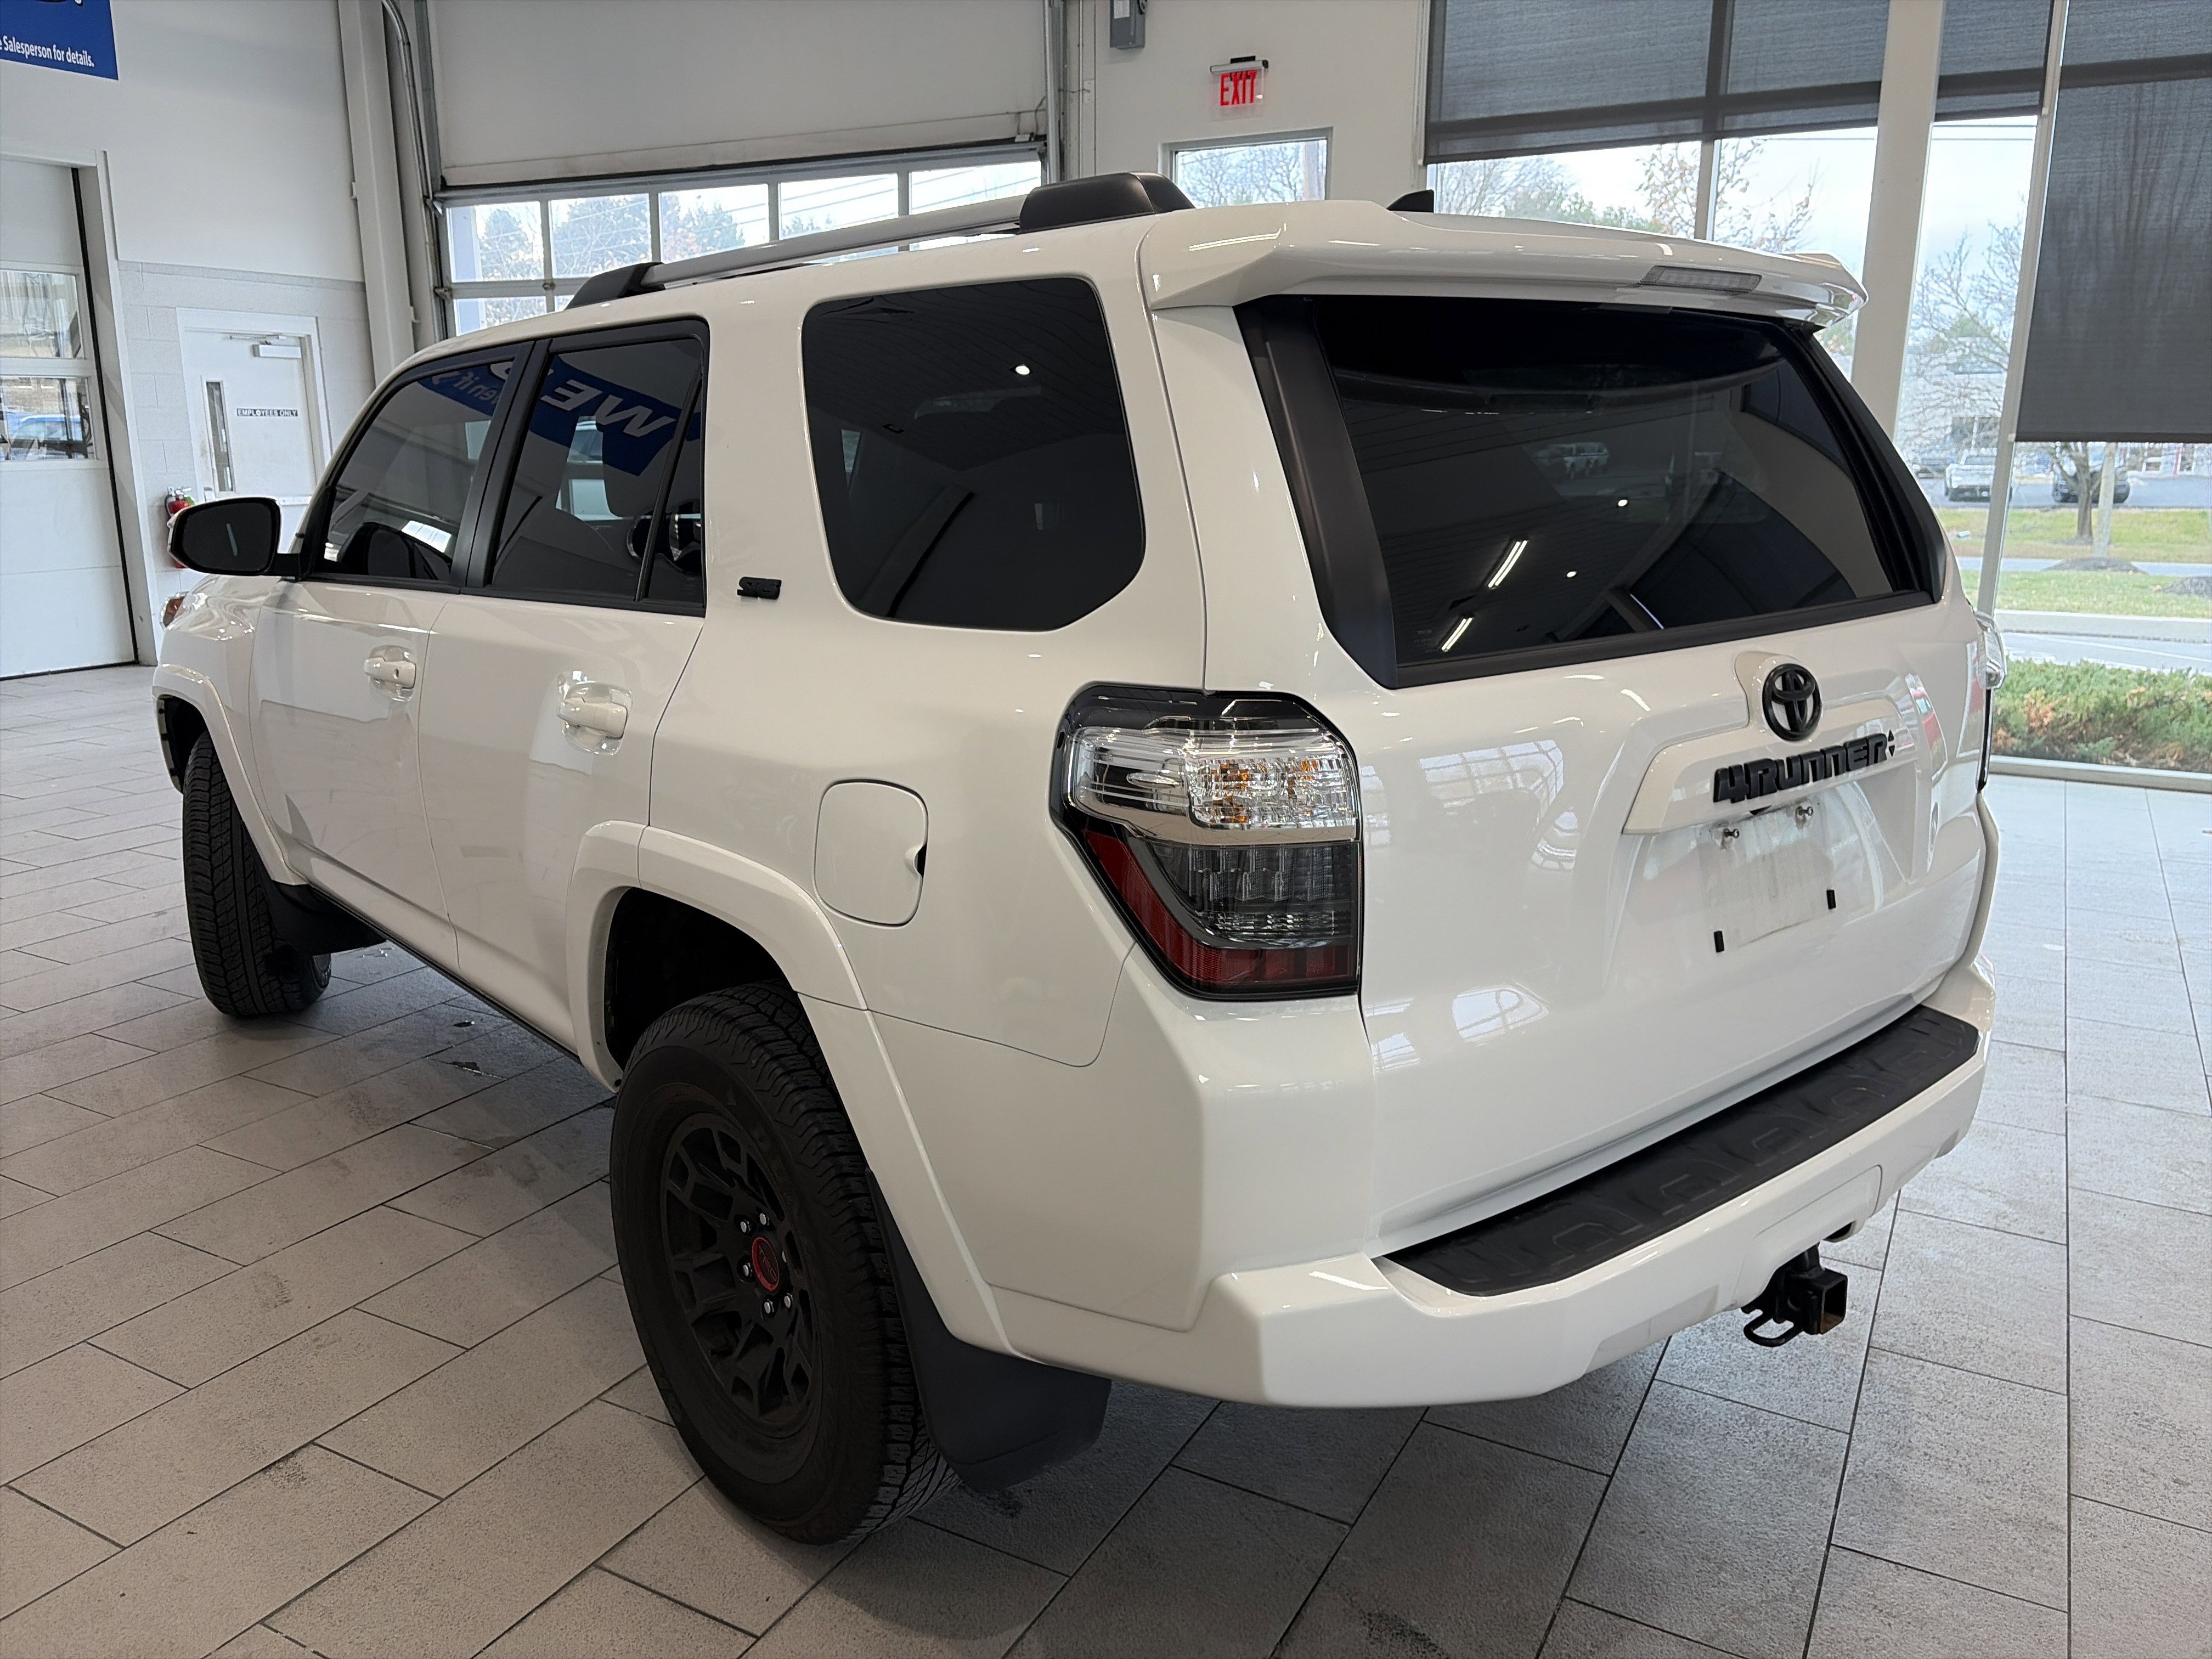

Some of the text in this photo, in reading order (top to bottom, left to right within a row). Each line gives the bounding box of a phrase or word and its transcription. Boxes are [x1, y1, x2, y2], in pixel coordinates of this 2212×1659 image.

[3, 35, 52, 59] Salesperson
[53, 44, 65, 61] for
[66, 47, 95, 67] details.
[1220, 70, 1257, 106] EXIT
[238, 408, 297, 417] EMPLOYEES ONLY
